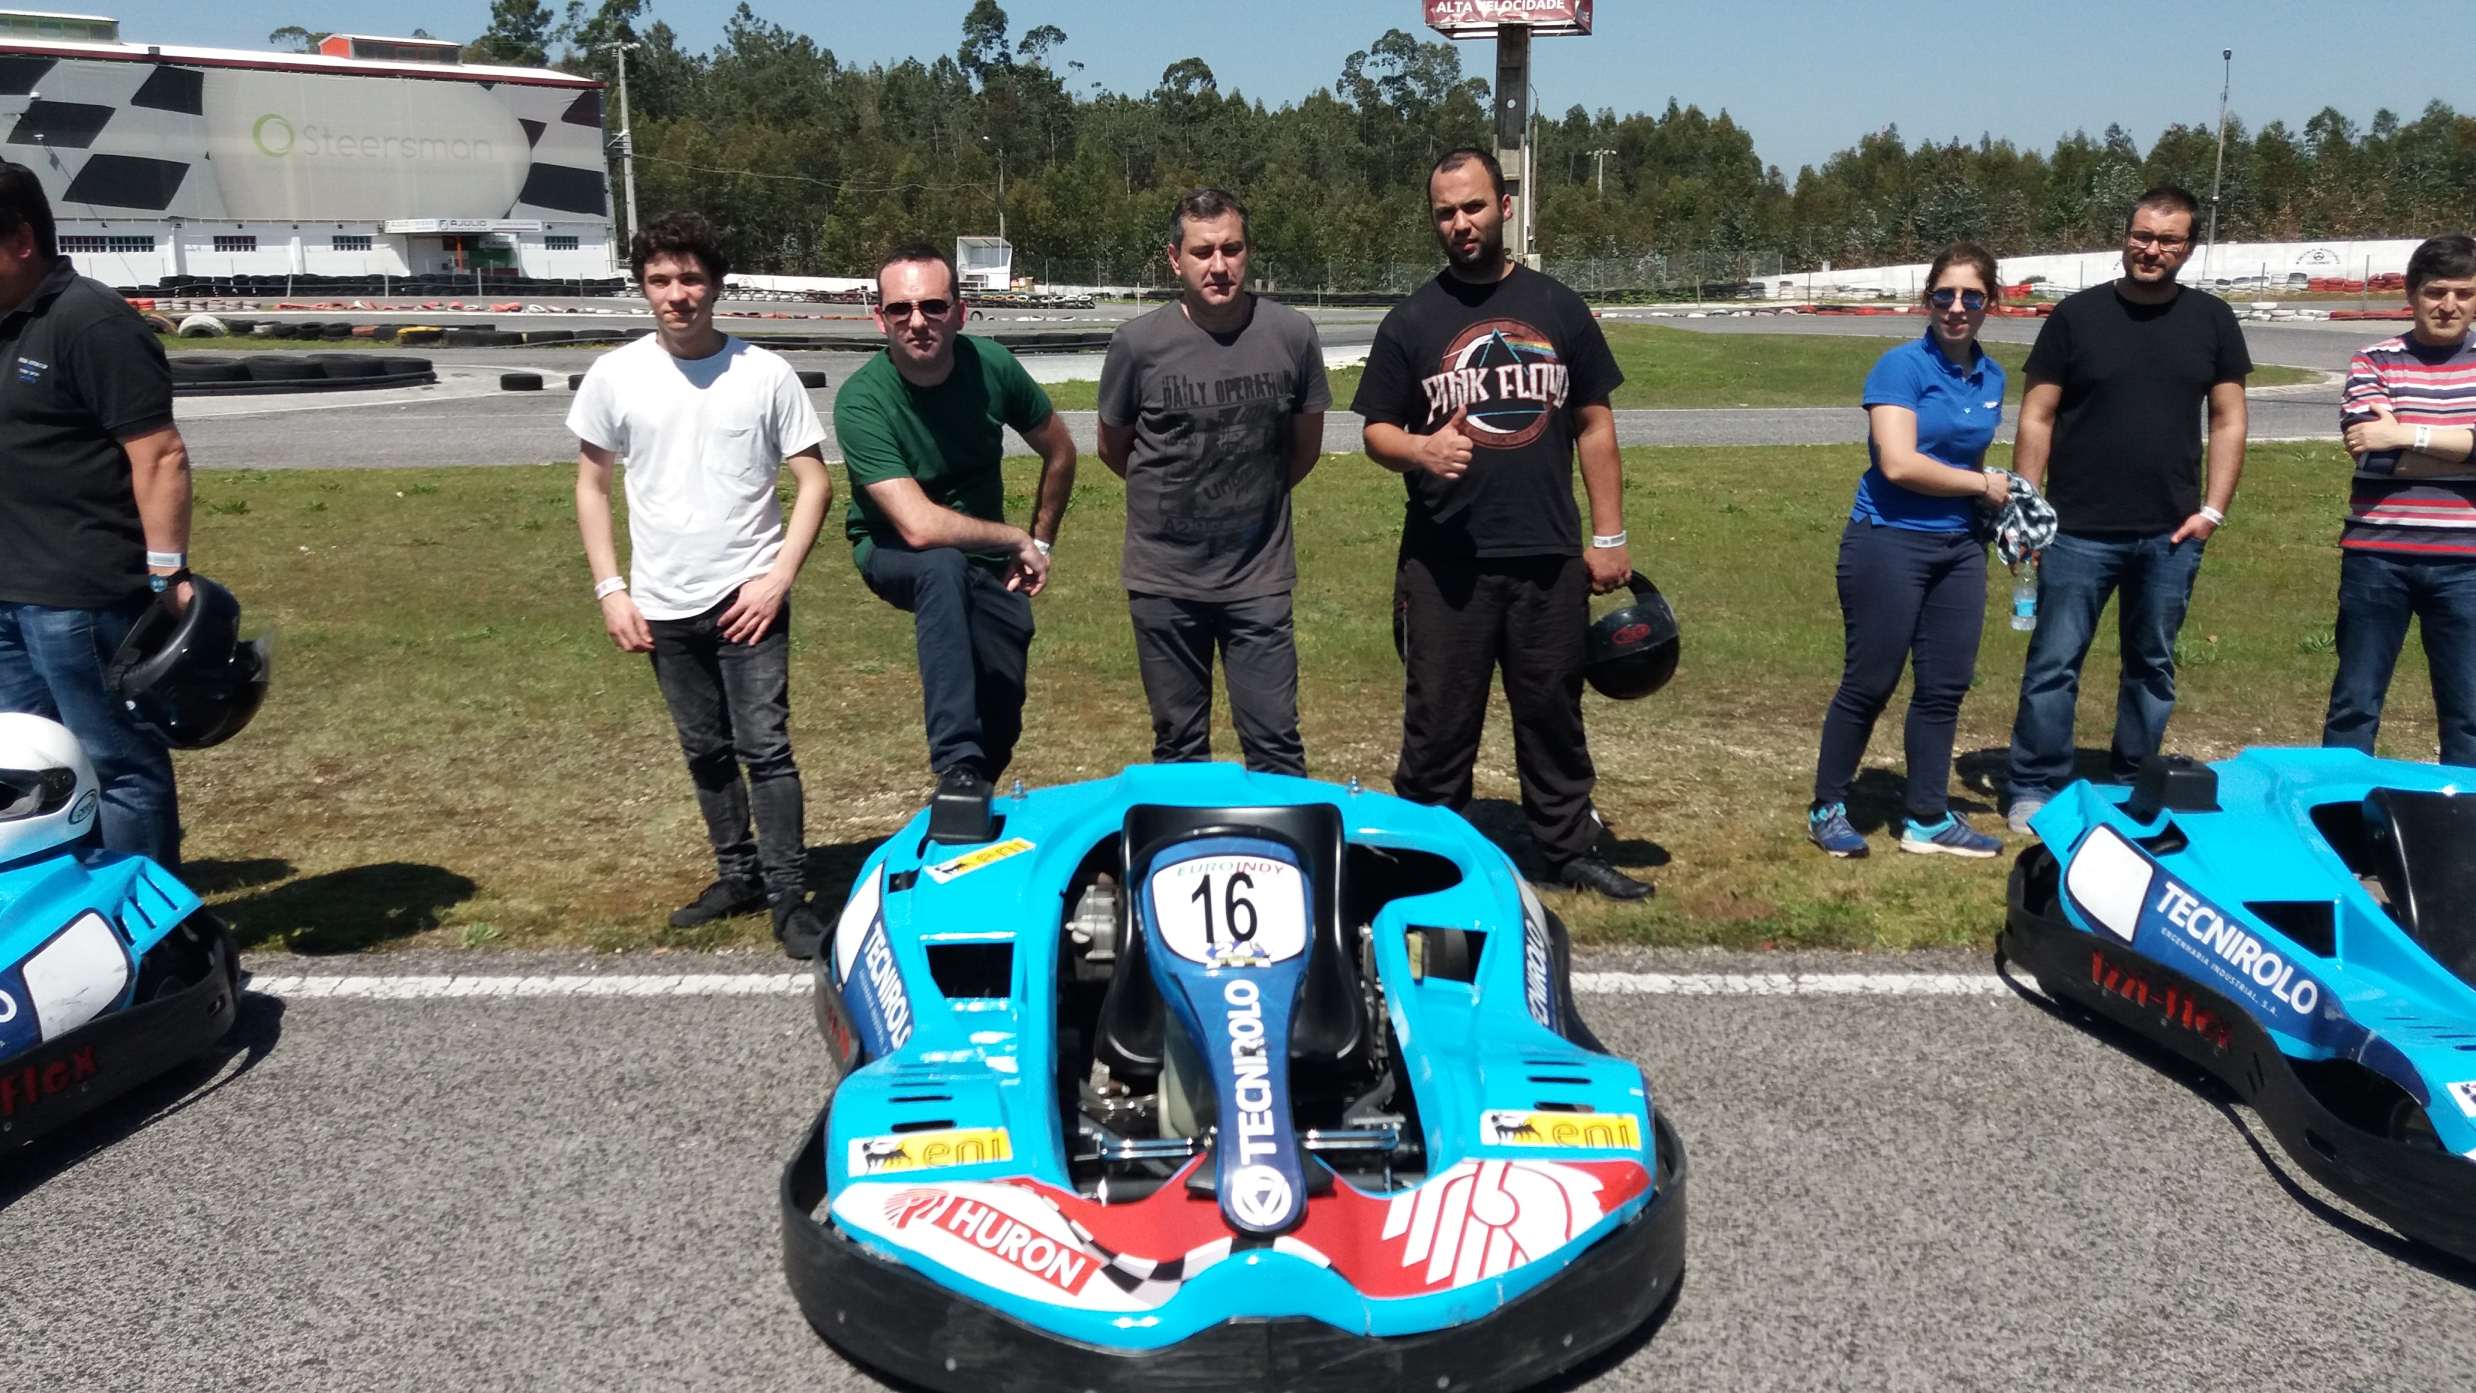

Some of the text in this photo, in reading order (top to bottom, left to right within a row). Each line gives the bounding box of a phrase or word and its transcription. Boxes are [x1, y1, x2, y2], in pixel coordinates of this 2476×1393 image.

[1436, 1, 1473, 13] ALTA
[302, 124, 494, 160] Steersman
[1163, 382, 1206, 409] DAILY
[1421, 362, 1570, 426] PINK FLOYD
[1177, 861, 1285, 877] EUROINDY
[1191, 872, 1258, 944] 16
[2156, 881, 2318, 1015] TECNIROLO
[1224, 979, 1277, 1166] TECNIROLO
[923, 1128, 1001, 1169] eni
[1552, 1114, 1632, 1149] eni
[948, 1200, 1086, 1289] HURON
